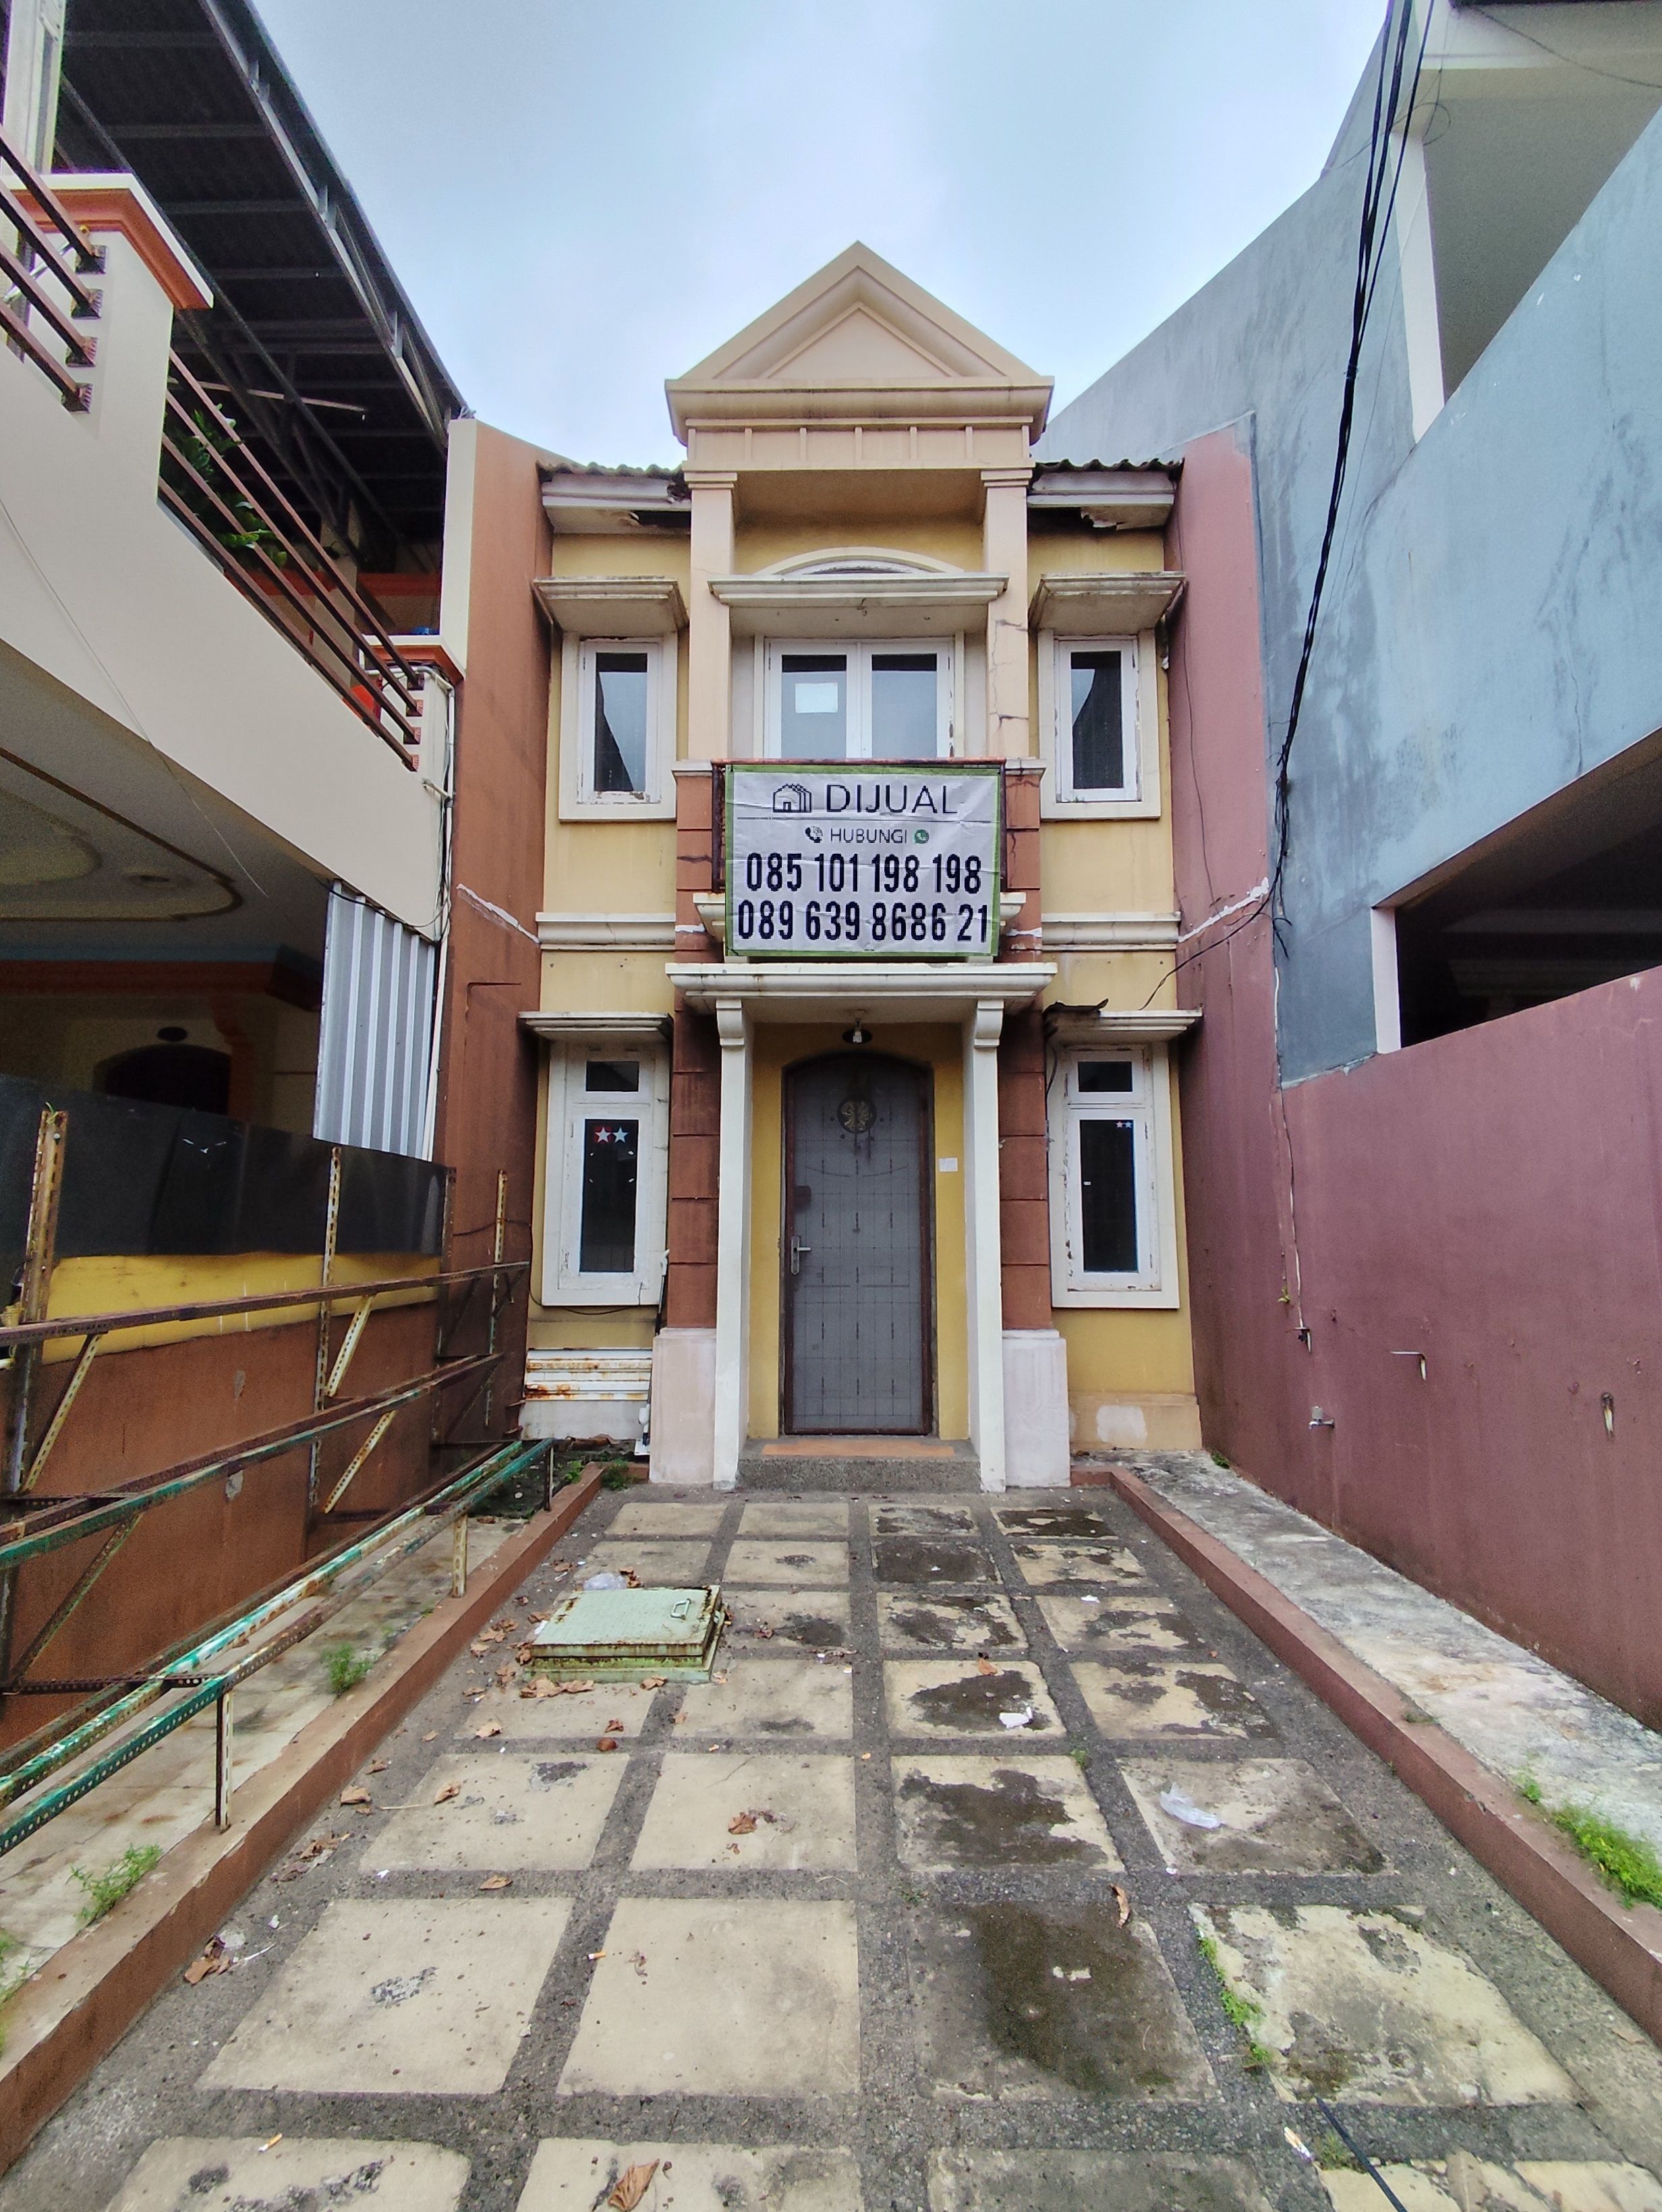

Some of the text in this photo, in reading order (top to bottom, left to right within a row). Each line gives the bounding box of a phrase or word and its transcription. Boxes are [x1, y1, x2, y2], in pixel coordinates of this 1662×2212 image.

[826, 784, 958, 814] DIJUAL
[830, 828, 907, 844] HUBUNGI
[746, 852, 981, 894] 085 101 198 198
[738, 900, 987, 943] 089 639 8686 21
